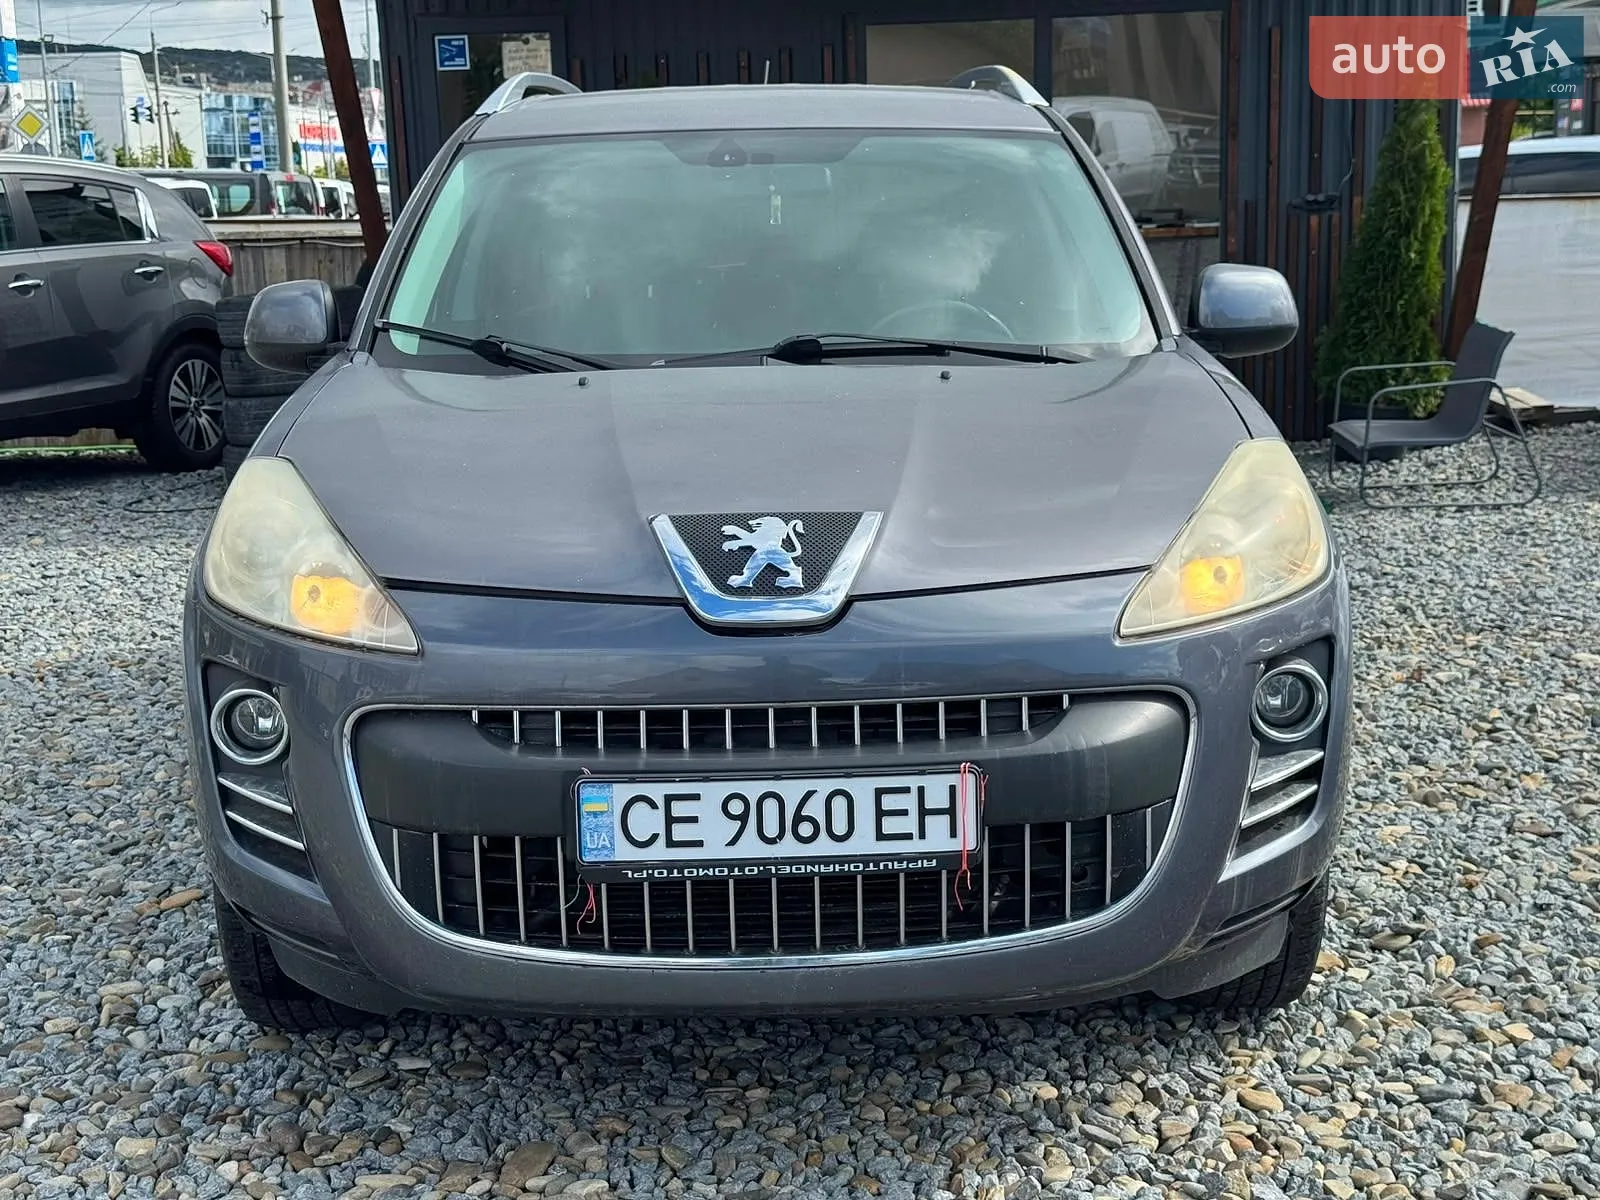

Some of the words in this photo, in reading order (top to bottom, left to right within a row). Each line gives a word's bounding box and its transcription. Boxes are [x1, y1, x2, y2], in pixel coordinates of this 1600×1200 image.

[620, 792, 704, 849] CE
[720, 788, 856, 847] 9060
[874, 784, 958, 842] EH
[586, 832, 612, 849] UA
